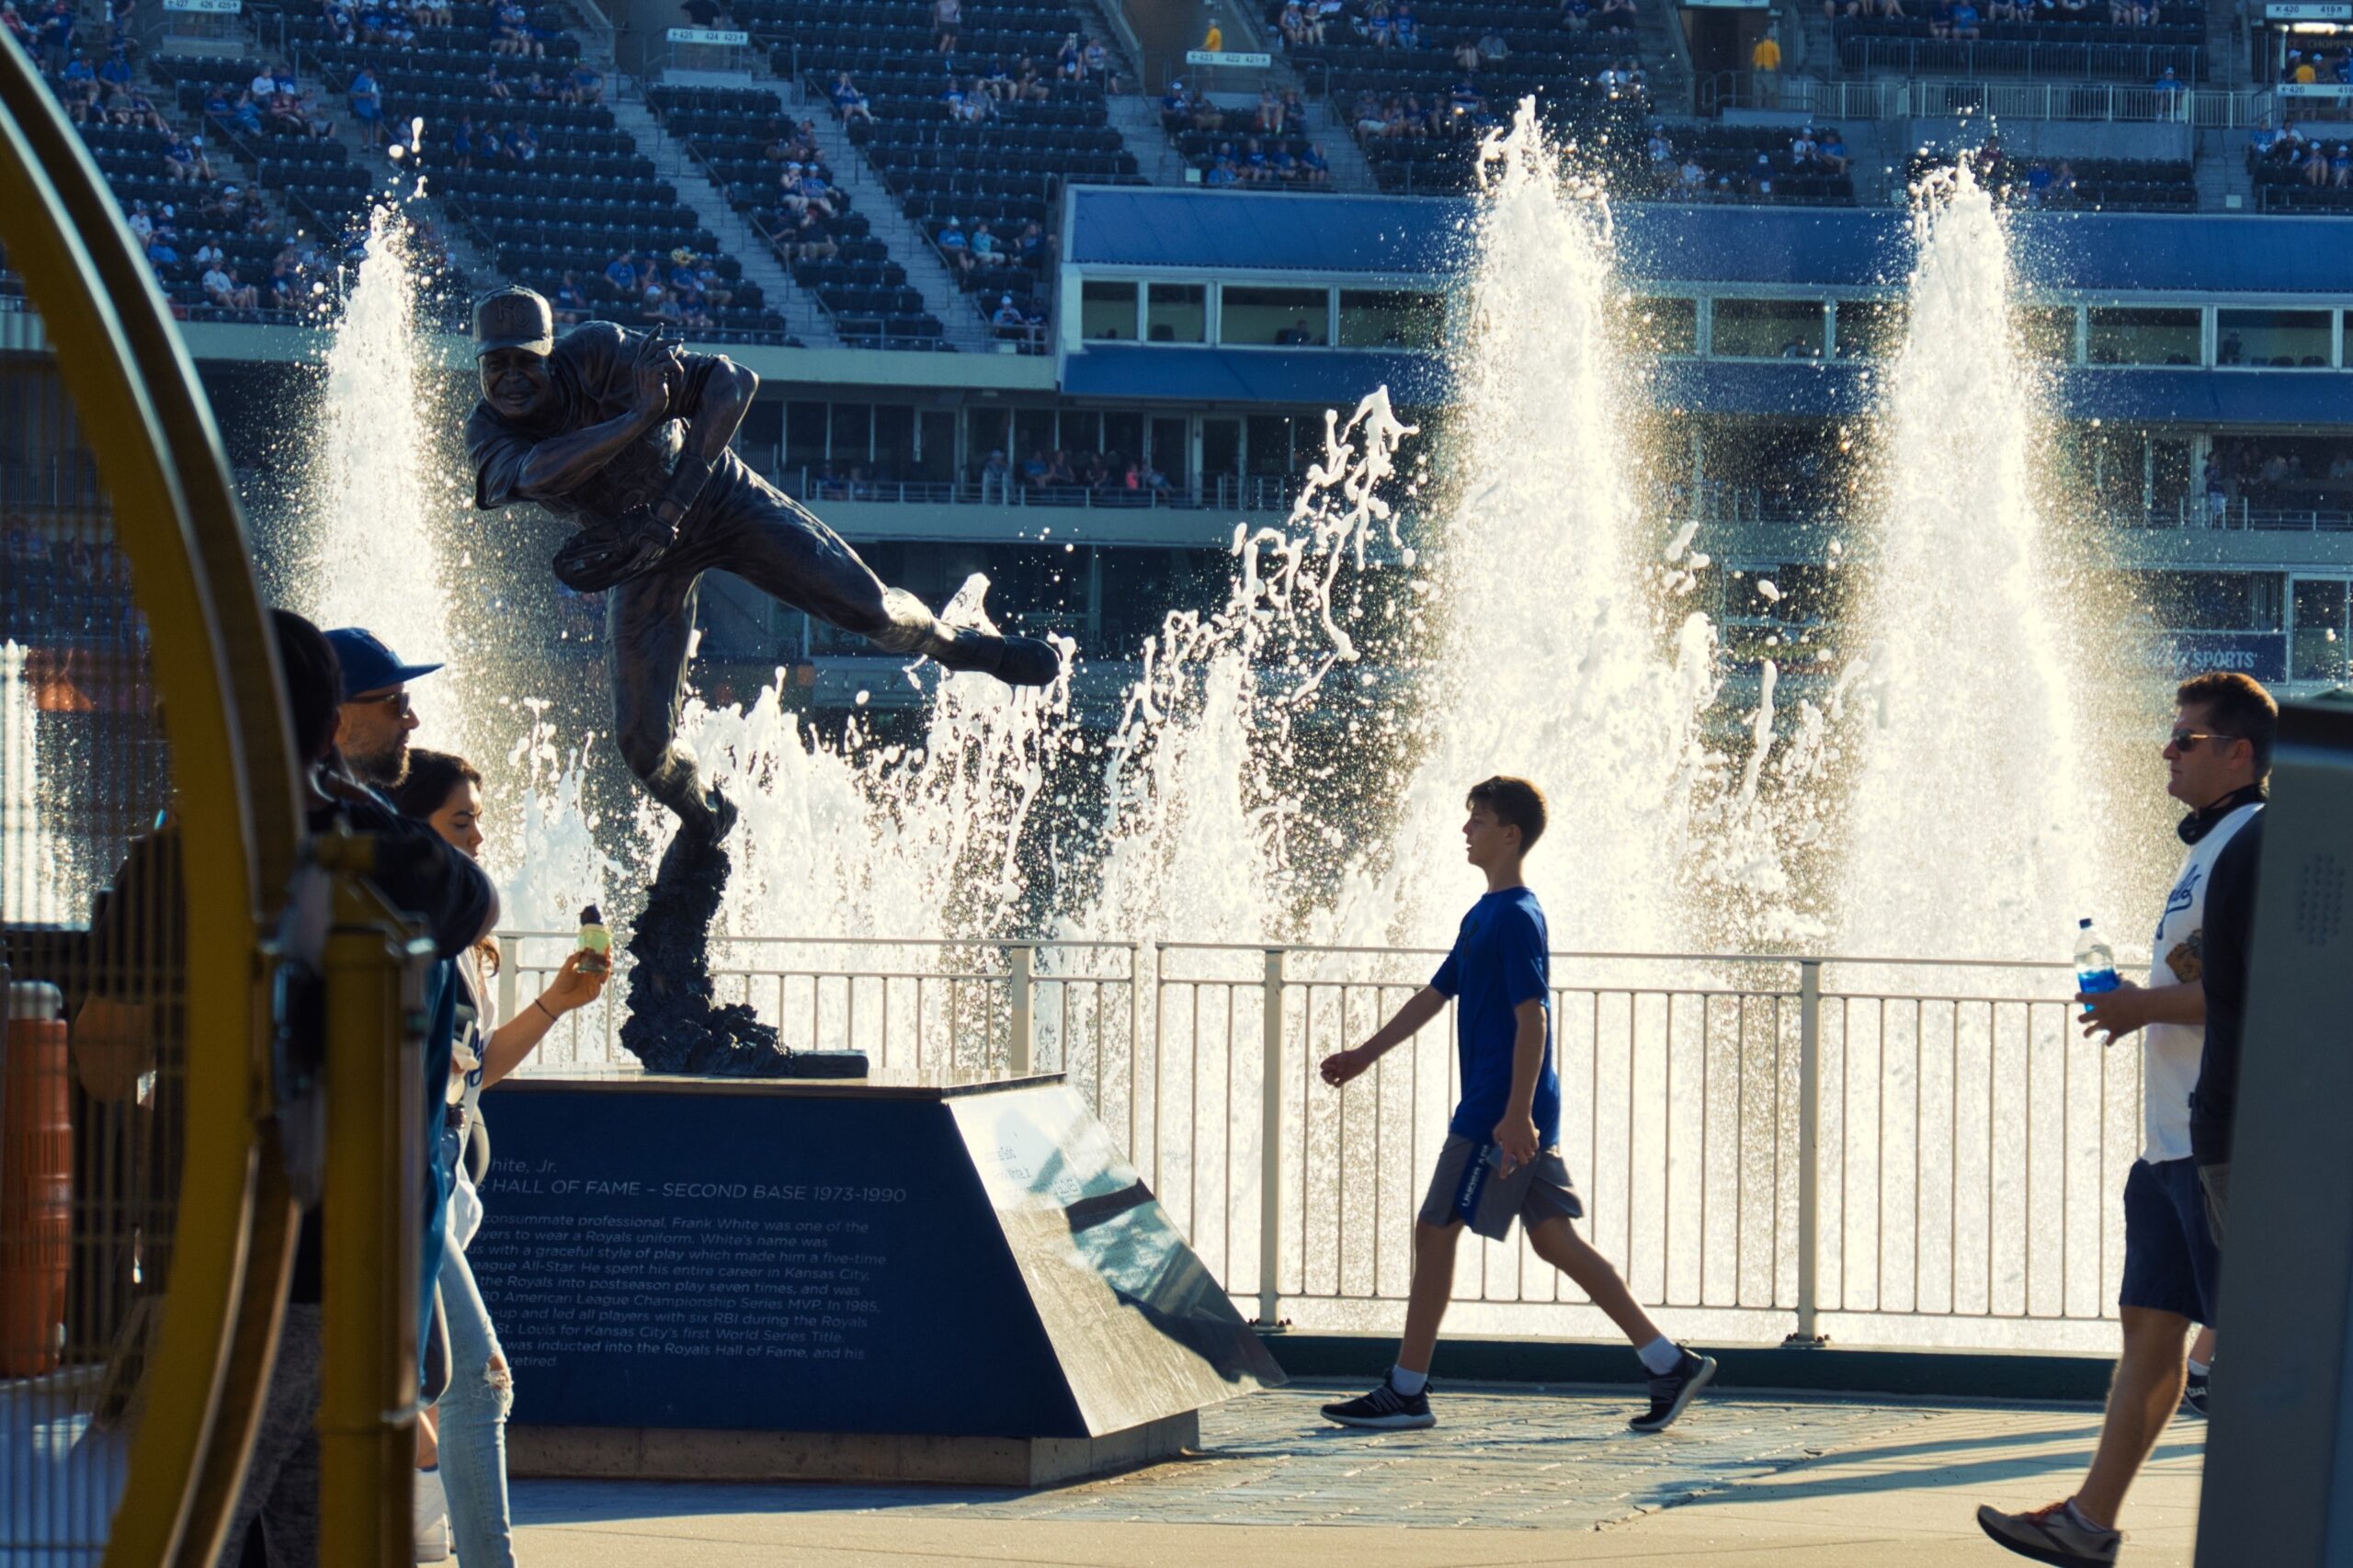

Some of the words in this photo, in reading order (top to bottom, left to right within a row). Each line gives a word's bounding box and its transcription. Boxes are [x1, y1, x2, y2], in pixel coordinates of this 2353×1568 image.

[705, 32, 718, 40] 424
[2193, 651, 2256, 669] SPORTS
[489, 1158, 531, 1173] hite,
[535, 1159, 558, 1174] Jr.
[491, 1178, 544, 1194] HALL
[550, 1180, 579, 1195] OF
[585, 1180, 641, 1196] FAME
[661, 1182, 748, 1199] SECOND
[752, 1184, 806, 1199] BASE
[813, 1186, 907, 1201] 1973-1990
[1461, 1167, 1482, 1207] UNDER
[671, 1216, 712, 1229] Frank
[715, 1217, 760, 1230] White
[762, 1221, 791, 1231] was
[794, 1221, 823, 1232] one
[824, 1220, 841, 1232] of
[844, 1220, 870, 1233] the
[514, 1228, 531, 1241] to
[533, 1232, 569, 1241] wear
[572, 1233, 582, 1242] a
[584, 1230, 633, 1245] Royals
[635, 1231, 696, 1244] uniform.
[699, 1232, 754, 1245] White's
[756, 1236, 798, 1246] name
[800, 1237, 828, 1247] was
[487, 1243, 519, 1256] with
[521, 1247, 531, 1256] a
[534, 1244, 594, 1261] graceful
[596, 1245, 632, 1261] style
[634, 1246, 651, 1259] of
[653, 1246, 686, 1263] play
[687, 1247, 732, 1260] which
[733, 1248, 776, 1262] made
[778, 1249, 806, 1262] him
[809, 1254, 819, 1263] a
[822, 1251, 887, 1264] five-time
[472, 1262, 517, 1275] eague
[579, 1261, 601, 1274] He
[603, 1262, 645, 1278] spent
[647, 1263, 670, 1275] his
[671, 1263, 715, 1277] entire
[717, 1267, 764, 1278] career
[767, 1266, 781, 1278] in
[783, 1266, 835, 1279] Kansas
[480, 1274, 504, 1287] the
[506, 1275, 554, 1291] Royals
[556, 1277, 586, 1289] into
[588, 1277, 672, 1294] postseason
[674, 1279, 706, 1295] play
[708, 1283, 750, 1293] seven
[800, 1282, 829, 1295] and
[832, 1286, 860, 1296] was
[503, 1290, 573, 1304] American
[574, 1291, 631, 1309] League
[631, 1293, 737, 1311] Championship
[739, 1296, 784, 1309] Series
[826, 1298, 841, 1311] In
[520, 1306, 549, 1319] and
[551, 1307, 575, 1320] led
[578, 1308, 596, 1321] all
[597, 1308, 651, 1324] players
[653, 1310, 686, 1323] with
[688, 1311, 710, 1324] six
[712, 1312, 739, 1324] RBI
[741, 1312, 790, 1328] during
[792, 1313, 818, 1326] the
[820, 1313, 869, 1330] Royals
[495, 1322, 514, 1335] St.
[517, 1323, 556, 1335] Louis
[559, 1324, 581, 1335] for
[584, 1324, 636, 1337] Kansas
[637, 1325, 679, 1342] City's
[681, 1326, 710, 1339] first
[714, 1327, 759, 1340] World
[762, 1328, 807, 1342] Series
[506, 1341, 533, 1350] was
[536, 1338, 601, 1352] inducted
[604, 1340, 633, 1353] into
[635, 1341, 661, 1354] the
[663, 1342, 711, 1358] Royals
[713, 1343, 743, 1356] Hall
[745, 1344, 762, 1357] of
[812, 1346, 841, 1358] and
[843, 1346, 865, 1358] his
